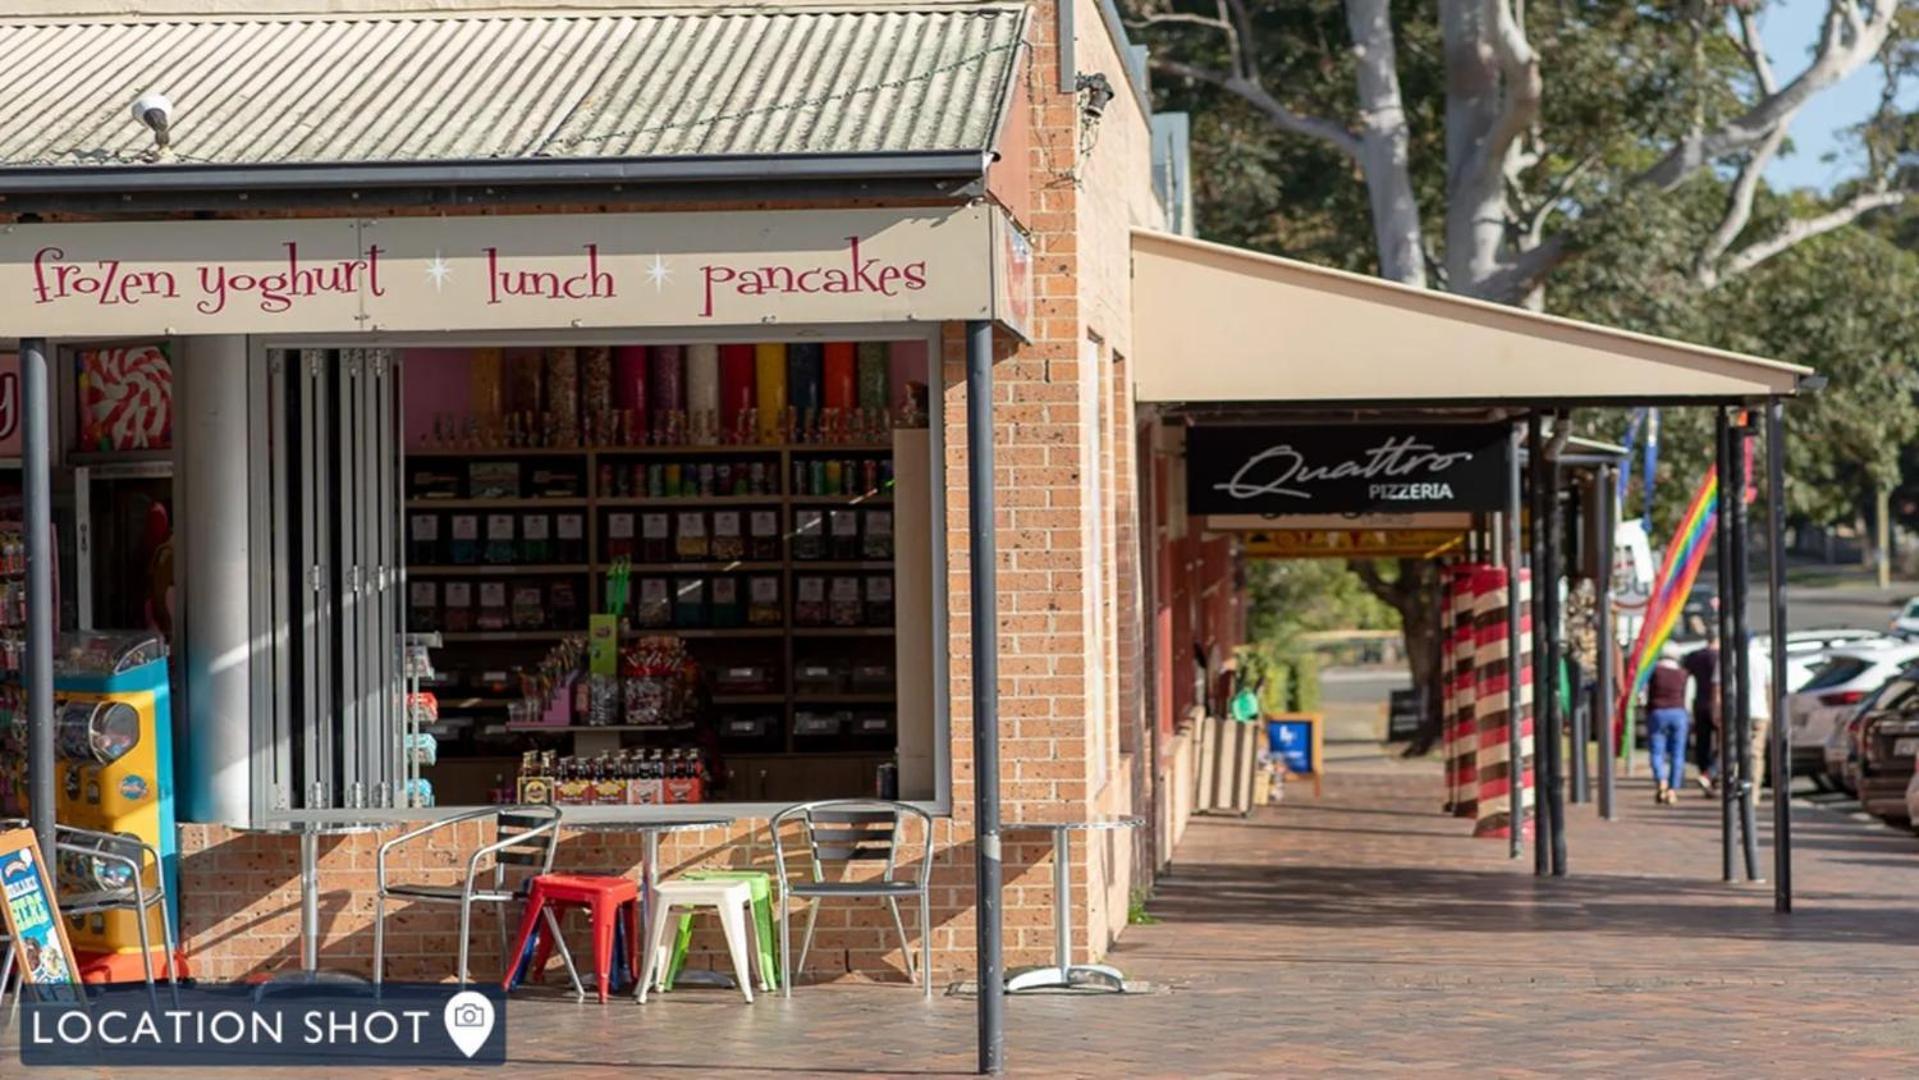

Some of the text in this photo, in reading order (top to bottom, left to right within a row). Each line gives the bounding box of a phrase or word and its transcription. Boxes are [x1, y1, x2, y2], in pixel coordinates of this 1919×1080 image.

[32, 236, 926, 318] frozen yoghurt lunch pancakes
[1213, 436, 1473, 500] Quattro
[1368, 483, 1455, 501] PIZZERIA
